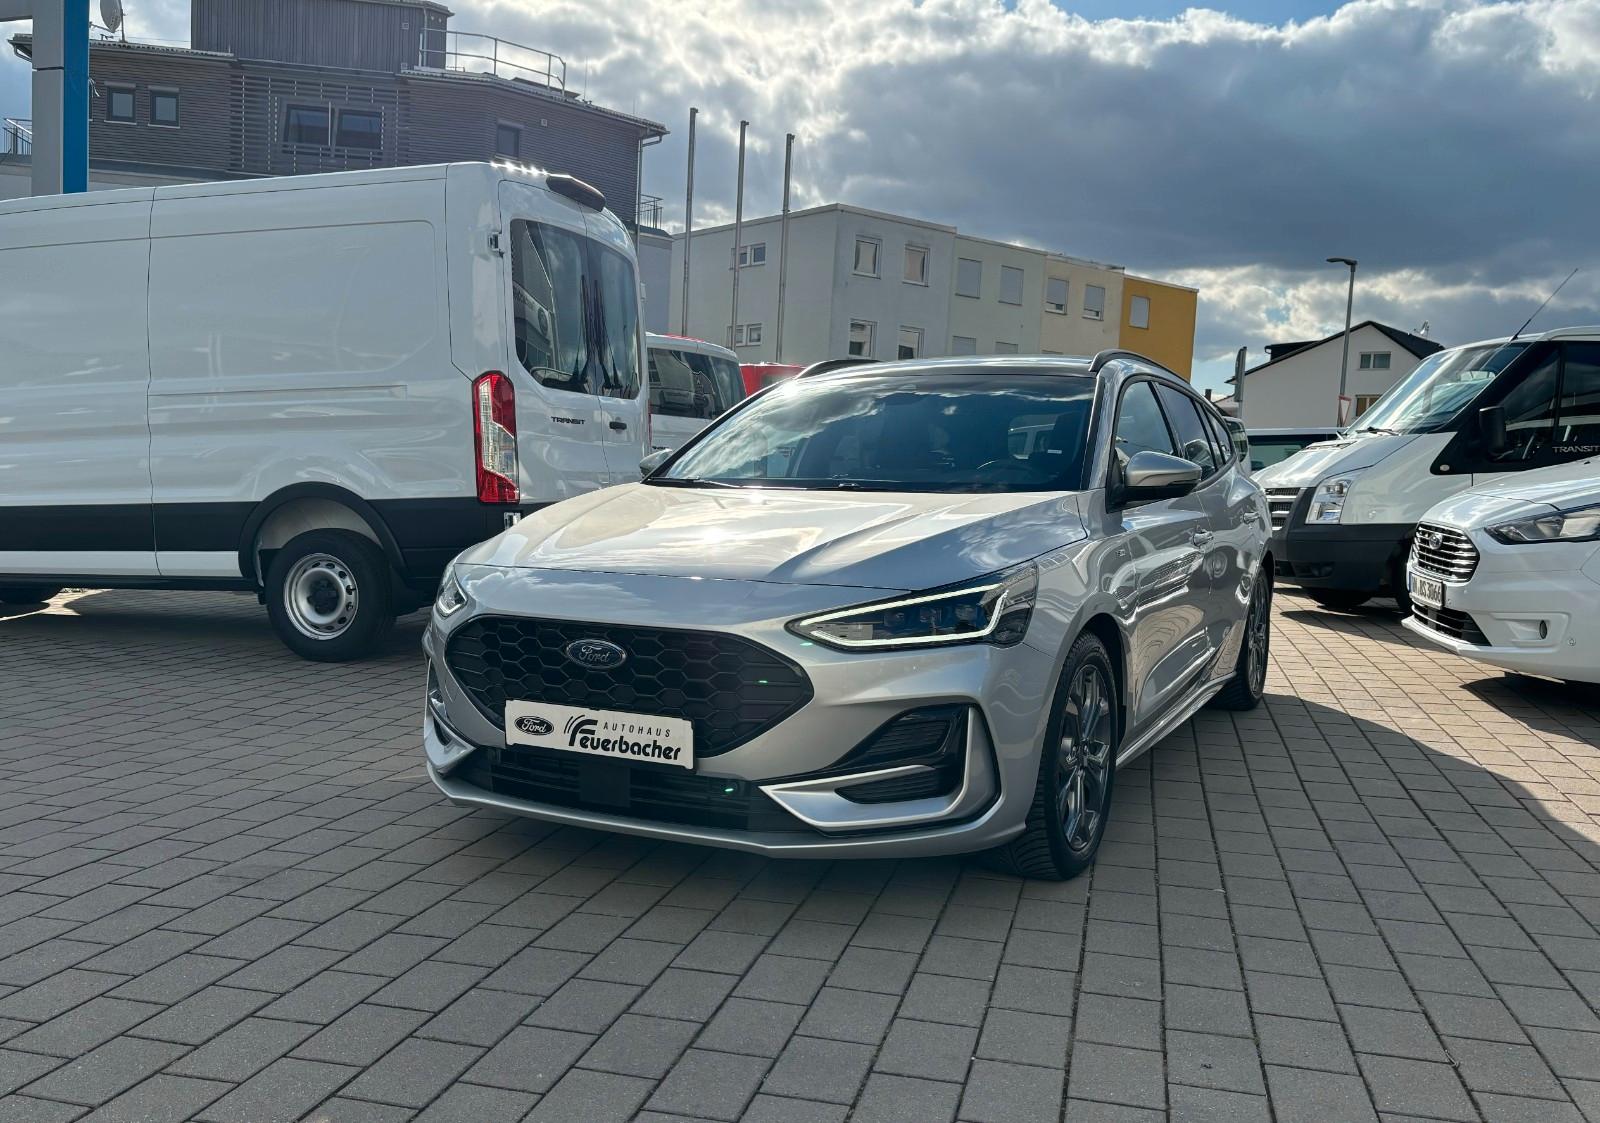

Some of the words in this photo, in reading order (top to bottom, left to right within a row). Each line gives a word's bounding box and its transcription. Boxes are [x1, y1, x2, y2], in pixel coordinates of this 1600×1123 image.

[551, 416, 585, 425] TRANSIT
[1552, 445, 1600, 453] TRANSIT
[521, 717, 548, 734] Ford
[603, 721, 671, 738] AUTOHAUS
[568, 719, 681, 760] Feuerbacher
